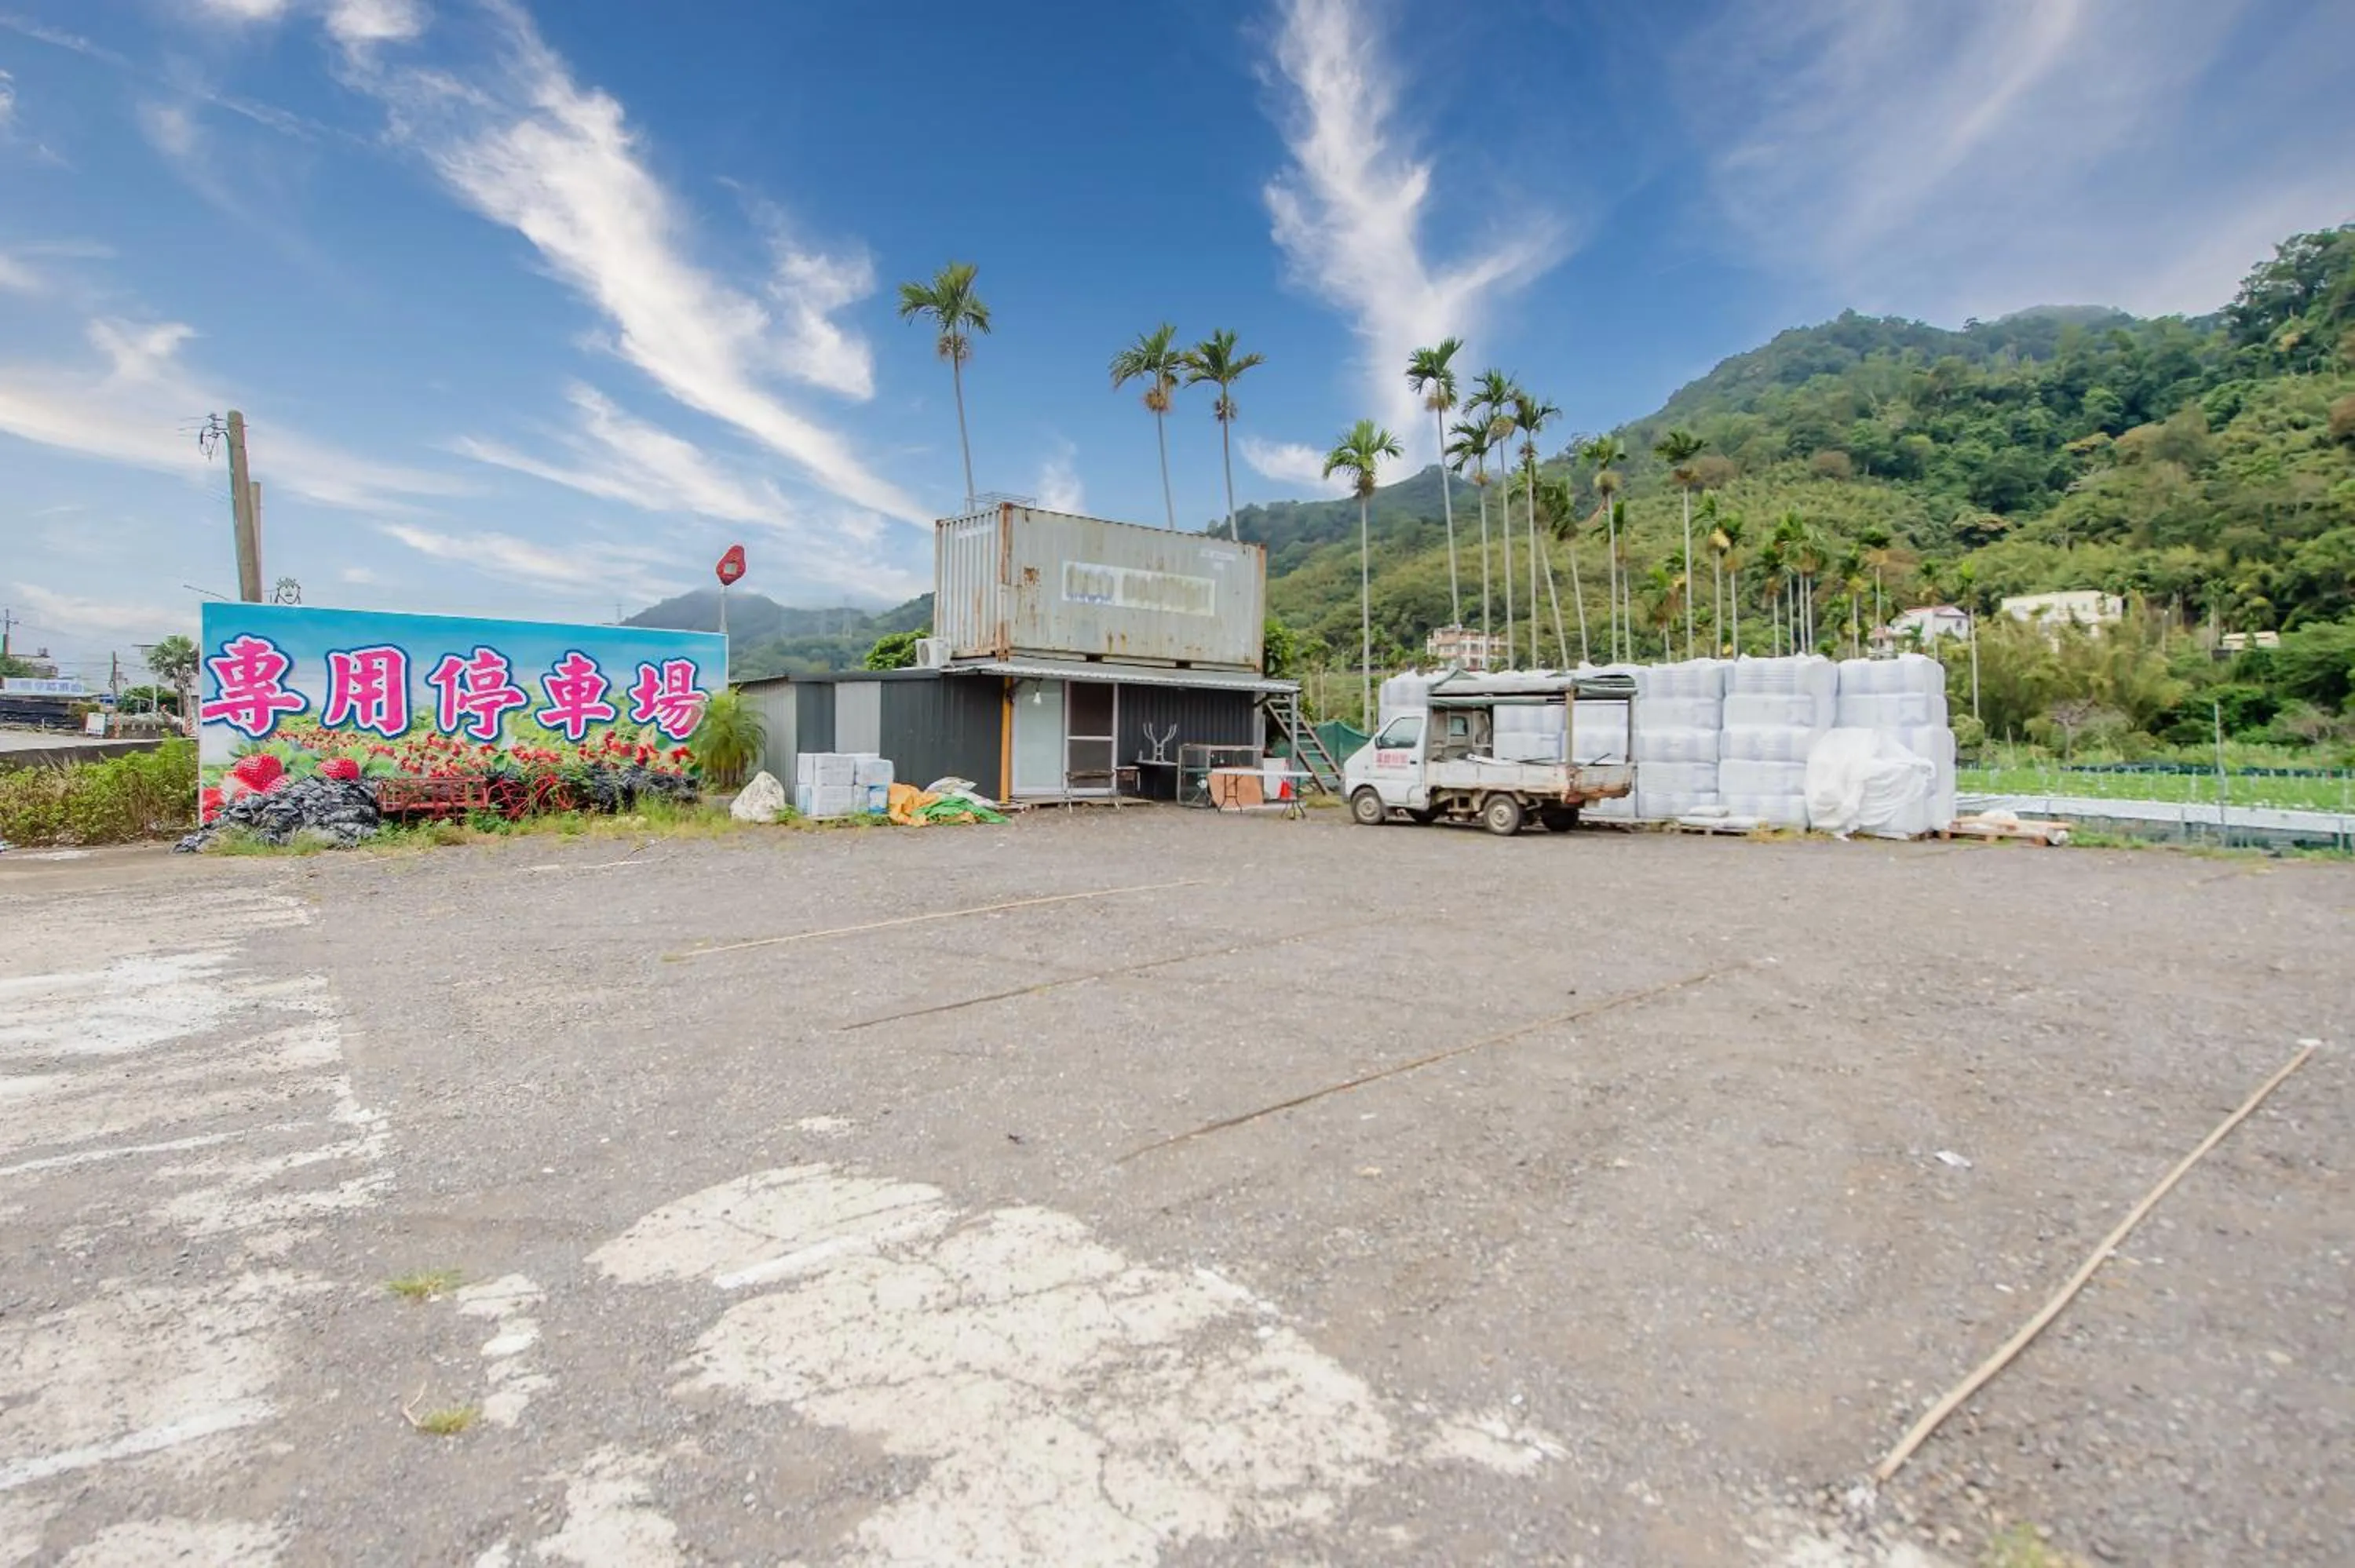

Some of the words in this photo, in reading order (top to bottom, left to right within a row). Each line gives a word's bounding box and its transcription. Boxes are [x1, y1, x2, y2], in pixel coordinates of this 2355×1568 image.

[202, 633, 710, 741] 專用停車場
